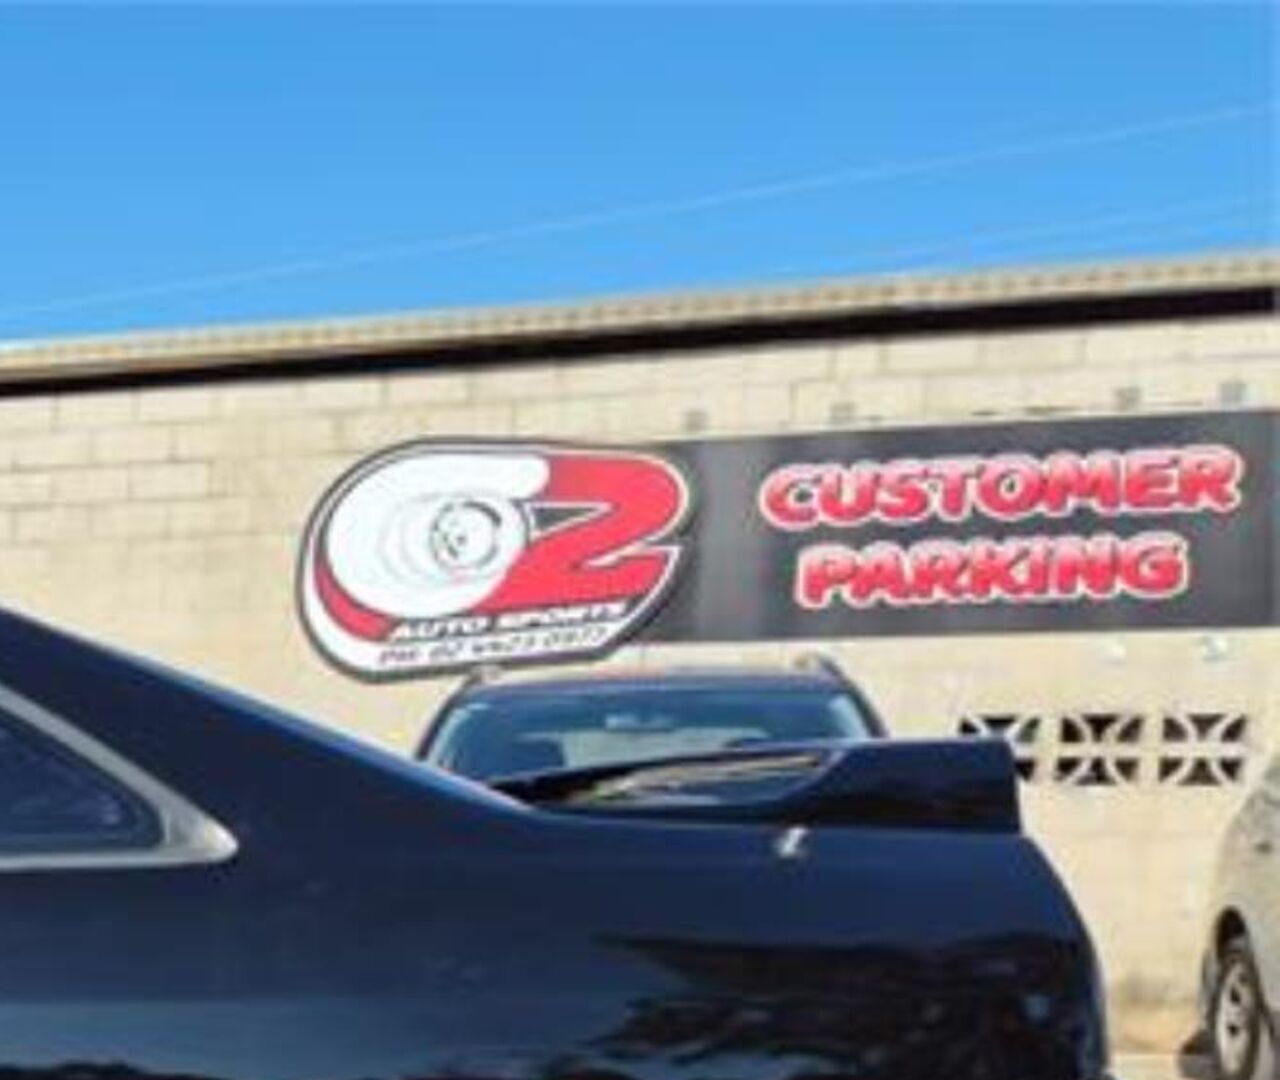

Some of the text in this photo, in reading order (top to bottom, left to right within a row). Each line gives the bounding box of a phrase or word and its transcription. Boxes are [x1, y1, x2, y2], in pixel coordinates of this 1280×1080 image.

[758, 445, 1244, 529] CUSTOMER
[794, 530, 1188, 609] PARKING
[390, 616, 493, 640] AUTO
